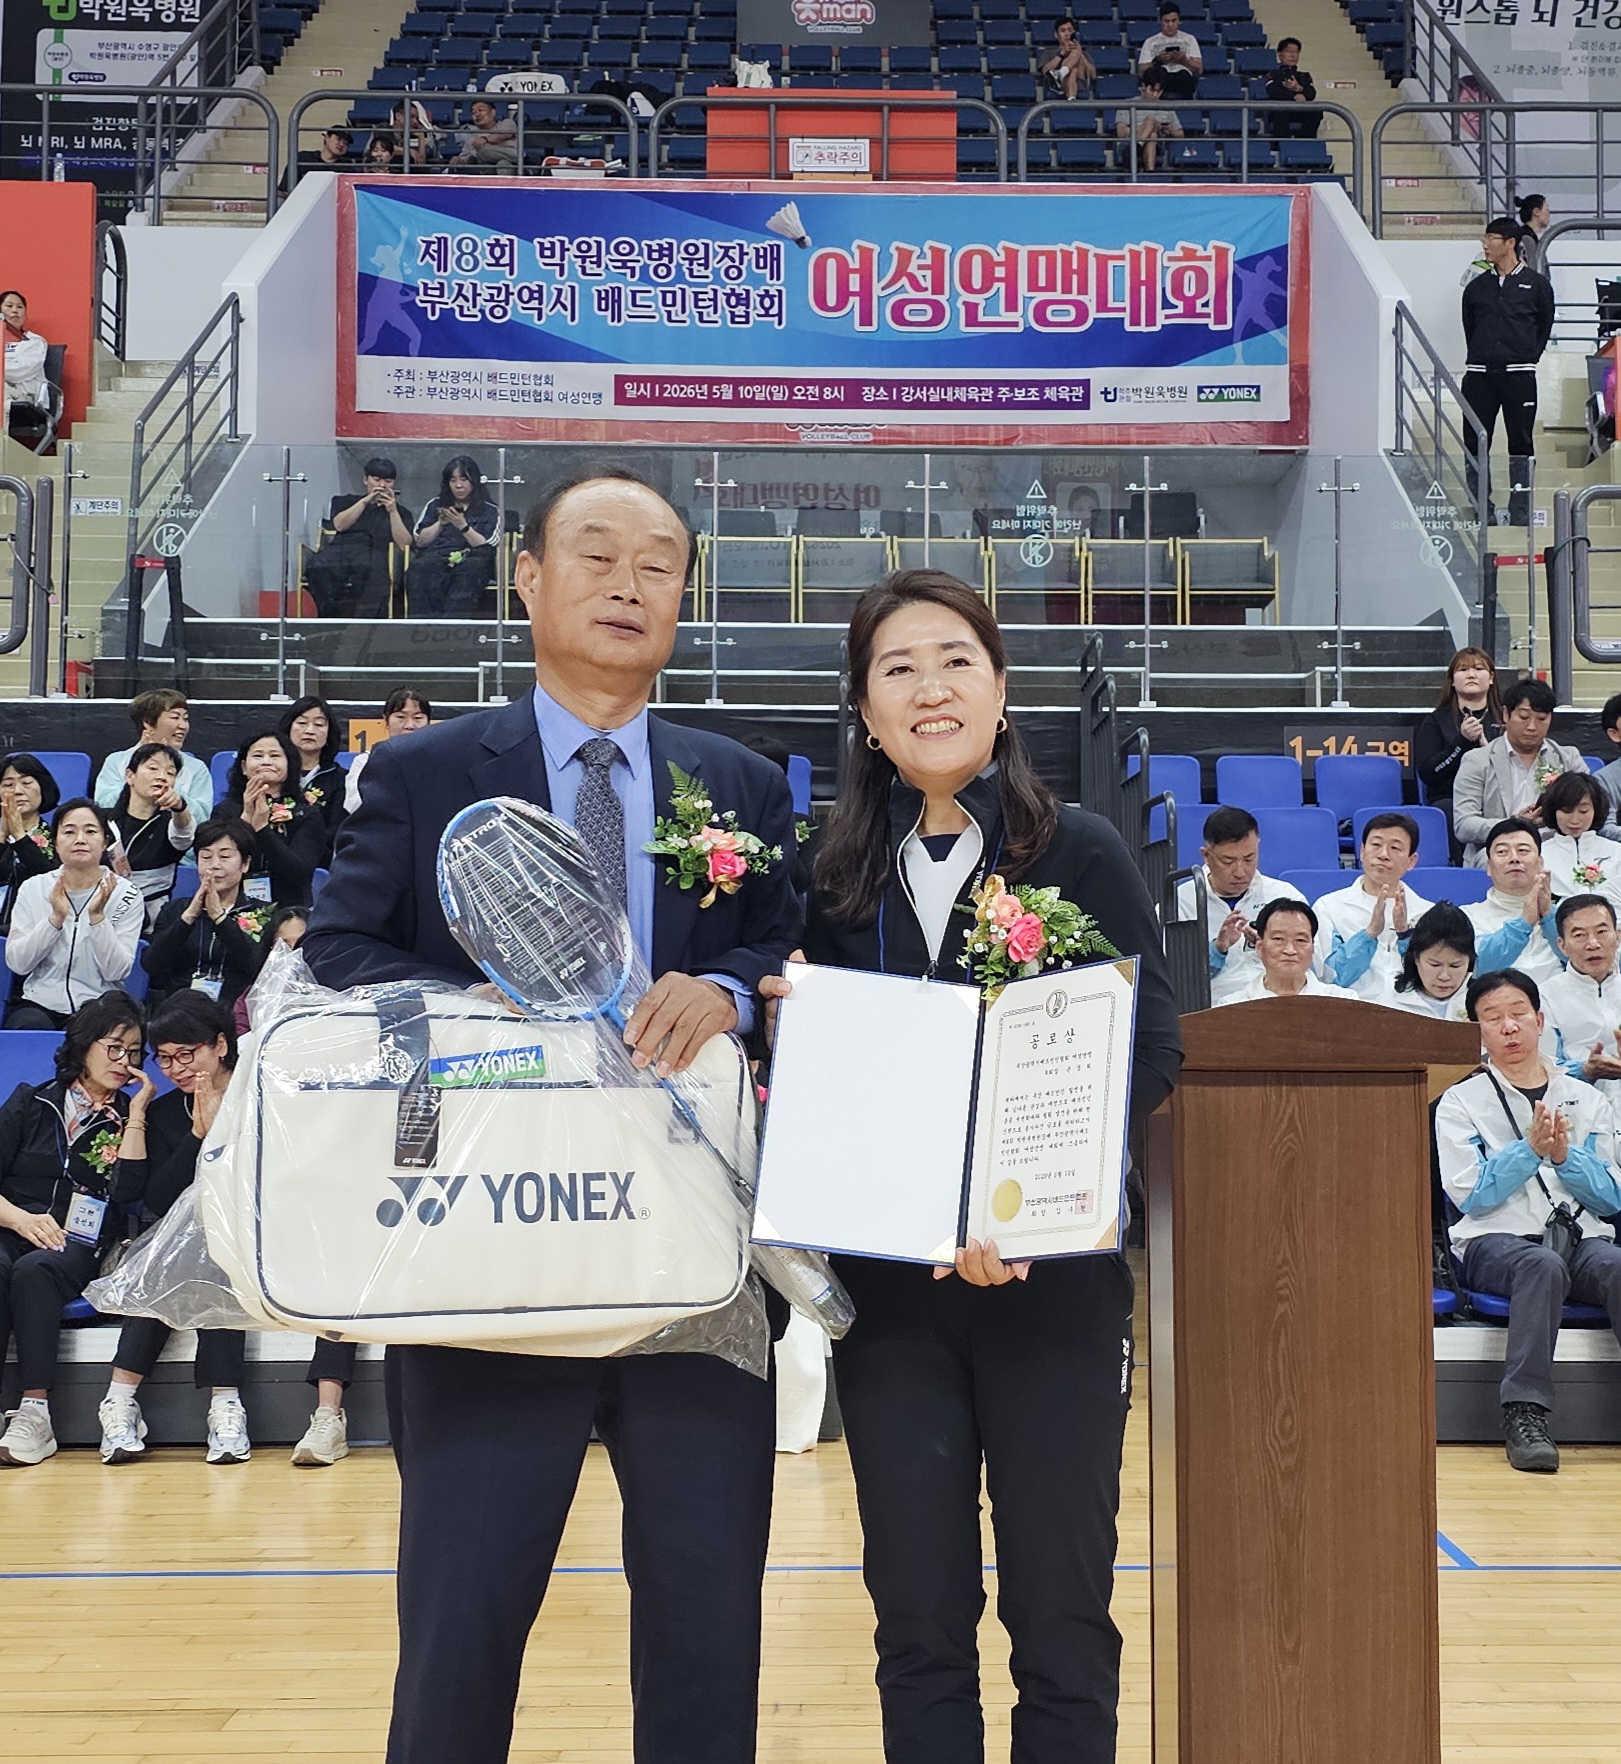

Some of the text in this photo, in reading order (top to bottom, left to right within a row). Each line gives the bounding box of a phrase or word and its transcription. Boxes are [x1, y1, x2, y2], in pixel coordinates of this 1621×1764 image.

[74, 136, 85, 149] 뇌
[90, 137, 127, 150] MRA,
[814, 151, 862, 164] 추락주의
[418, 234, 1234, 331] 제8회 박원욱병원장배 여성연맹대회
[418, 281, 785, 326] 부산광역시 배드민턴협회
[393, 369, 554, 386] 주최 부산광역시 배드민턴협회
[393, 386, 603, 406] 주관 부산광역시 배드민턴협회 여성연맹
[624, 382, 651, 398] 일시
[663, 384, 708, 400] 2026년
[712, 384, 734, 400] 5월
[738, 386, 788, 401] 10일(일)
[792, 386, 820, 402] 오전
[823, 386, 844, 402] 8시
[861, 386, 889, 401] 장소
[901, 386, 993, 402] 강서실내체육관
[1043, 386, 1084, 402] 체육관
[1132, 385, 1188, 399] 박원욱병원
[1221, 388, 1258, 400] YONEX
[88, 500, 118, 510] 계단주의
[478, 1050, 539, 1077] YONEX
[481, 1171, 637, 1224] YONEX
